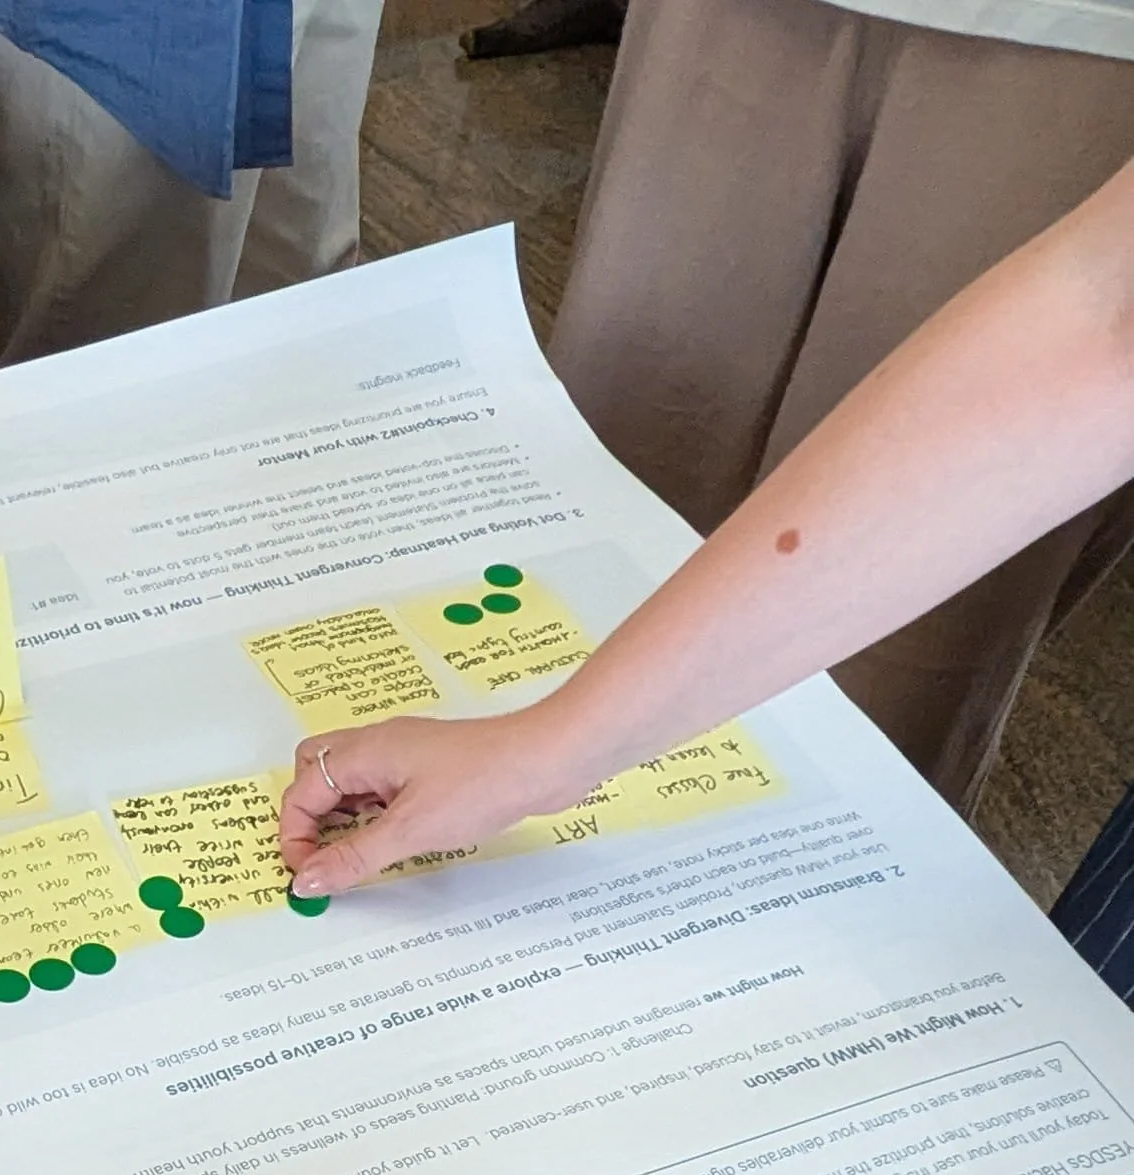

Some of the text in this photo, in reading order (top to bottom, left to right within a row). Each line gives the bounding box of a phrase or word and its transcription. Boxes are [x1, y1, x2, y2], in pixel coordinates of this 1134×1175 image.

[379, 411, 479, 440] Checkpoint#2
[312, 439, 345, 455] your
[345, 433, 379, 448] with
[257, 448, 311, 467] Mentor
[488, 517, 539, 533] Voting
[537, 511, 567, 525] Dot
[458, 527, 488, 542] and
[384, 534, 460, 560] Heatmap:
[294, 554, 385, 582] Convergent
[224, 575, 295, 598] Thinking
[169, 596, 203, 612] now
[83, 620, 103, 631] to
[103, 611, 141, 626] time
[14, 623, 82, 649] prioritiz
[552, 814, 599, 845] ART
[165, 864, 906, 1096] 2. Brainstorm Ideas: Divergent Thinking explore a wide range of creative possibilities
[769, 964, 805, 982] How
[702, 990, 727, 1003] we
[725, 975, 770, 997] might
[632, 997, 702, 1025] reimagine
[554, 1019, 632, 1052] underused
[742, 996, 1023, 1089] 1. How Might We (HMW) question
[509, 1044, 554, 1064] urban
[454, 1058, 509, 1081] spaces
[997, 1065, 1046, 1086] Please
[434, 1075, 454, 1088] as
[959, 1079, 999, 1098] make
[331, 1082, 433, 1120] environments
[910, 1101, 930, 1114] to
[927, 1091, 960, 1108] sure
[296, 1114, 331, 1132] that
[859, 1107, 910, 1132] submit
[233, 1124, 295, 1151] support
[827, 1121, 860, 1143] your
[185, 1141, 233, 1166] youth
[737, 1135, 825, 1173] deliverables
